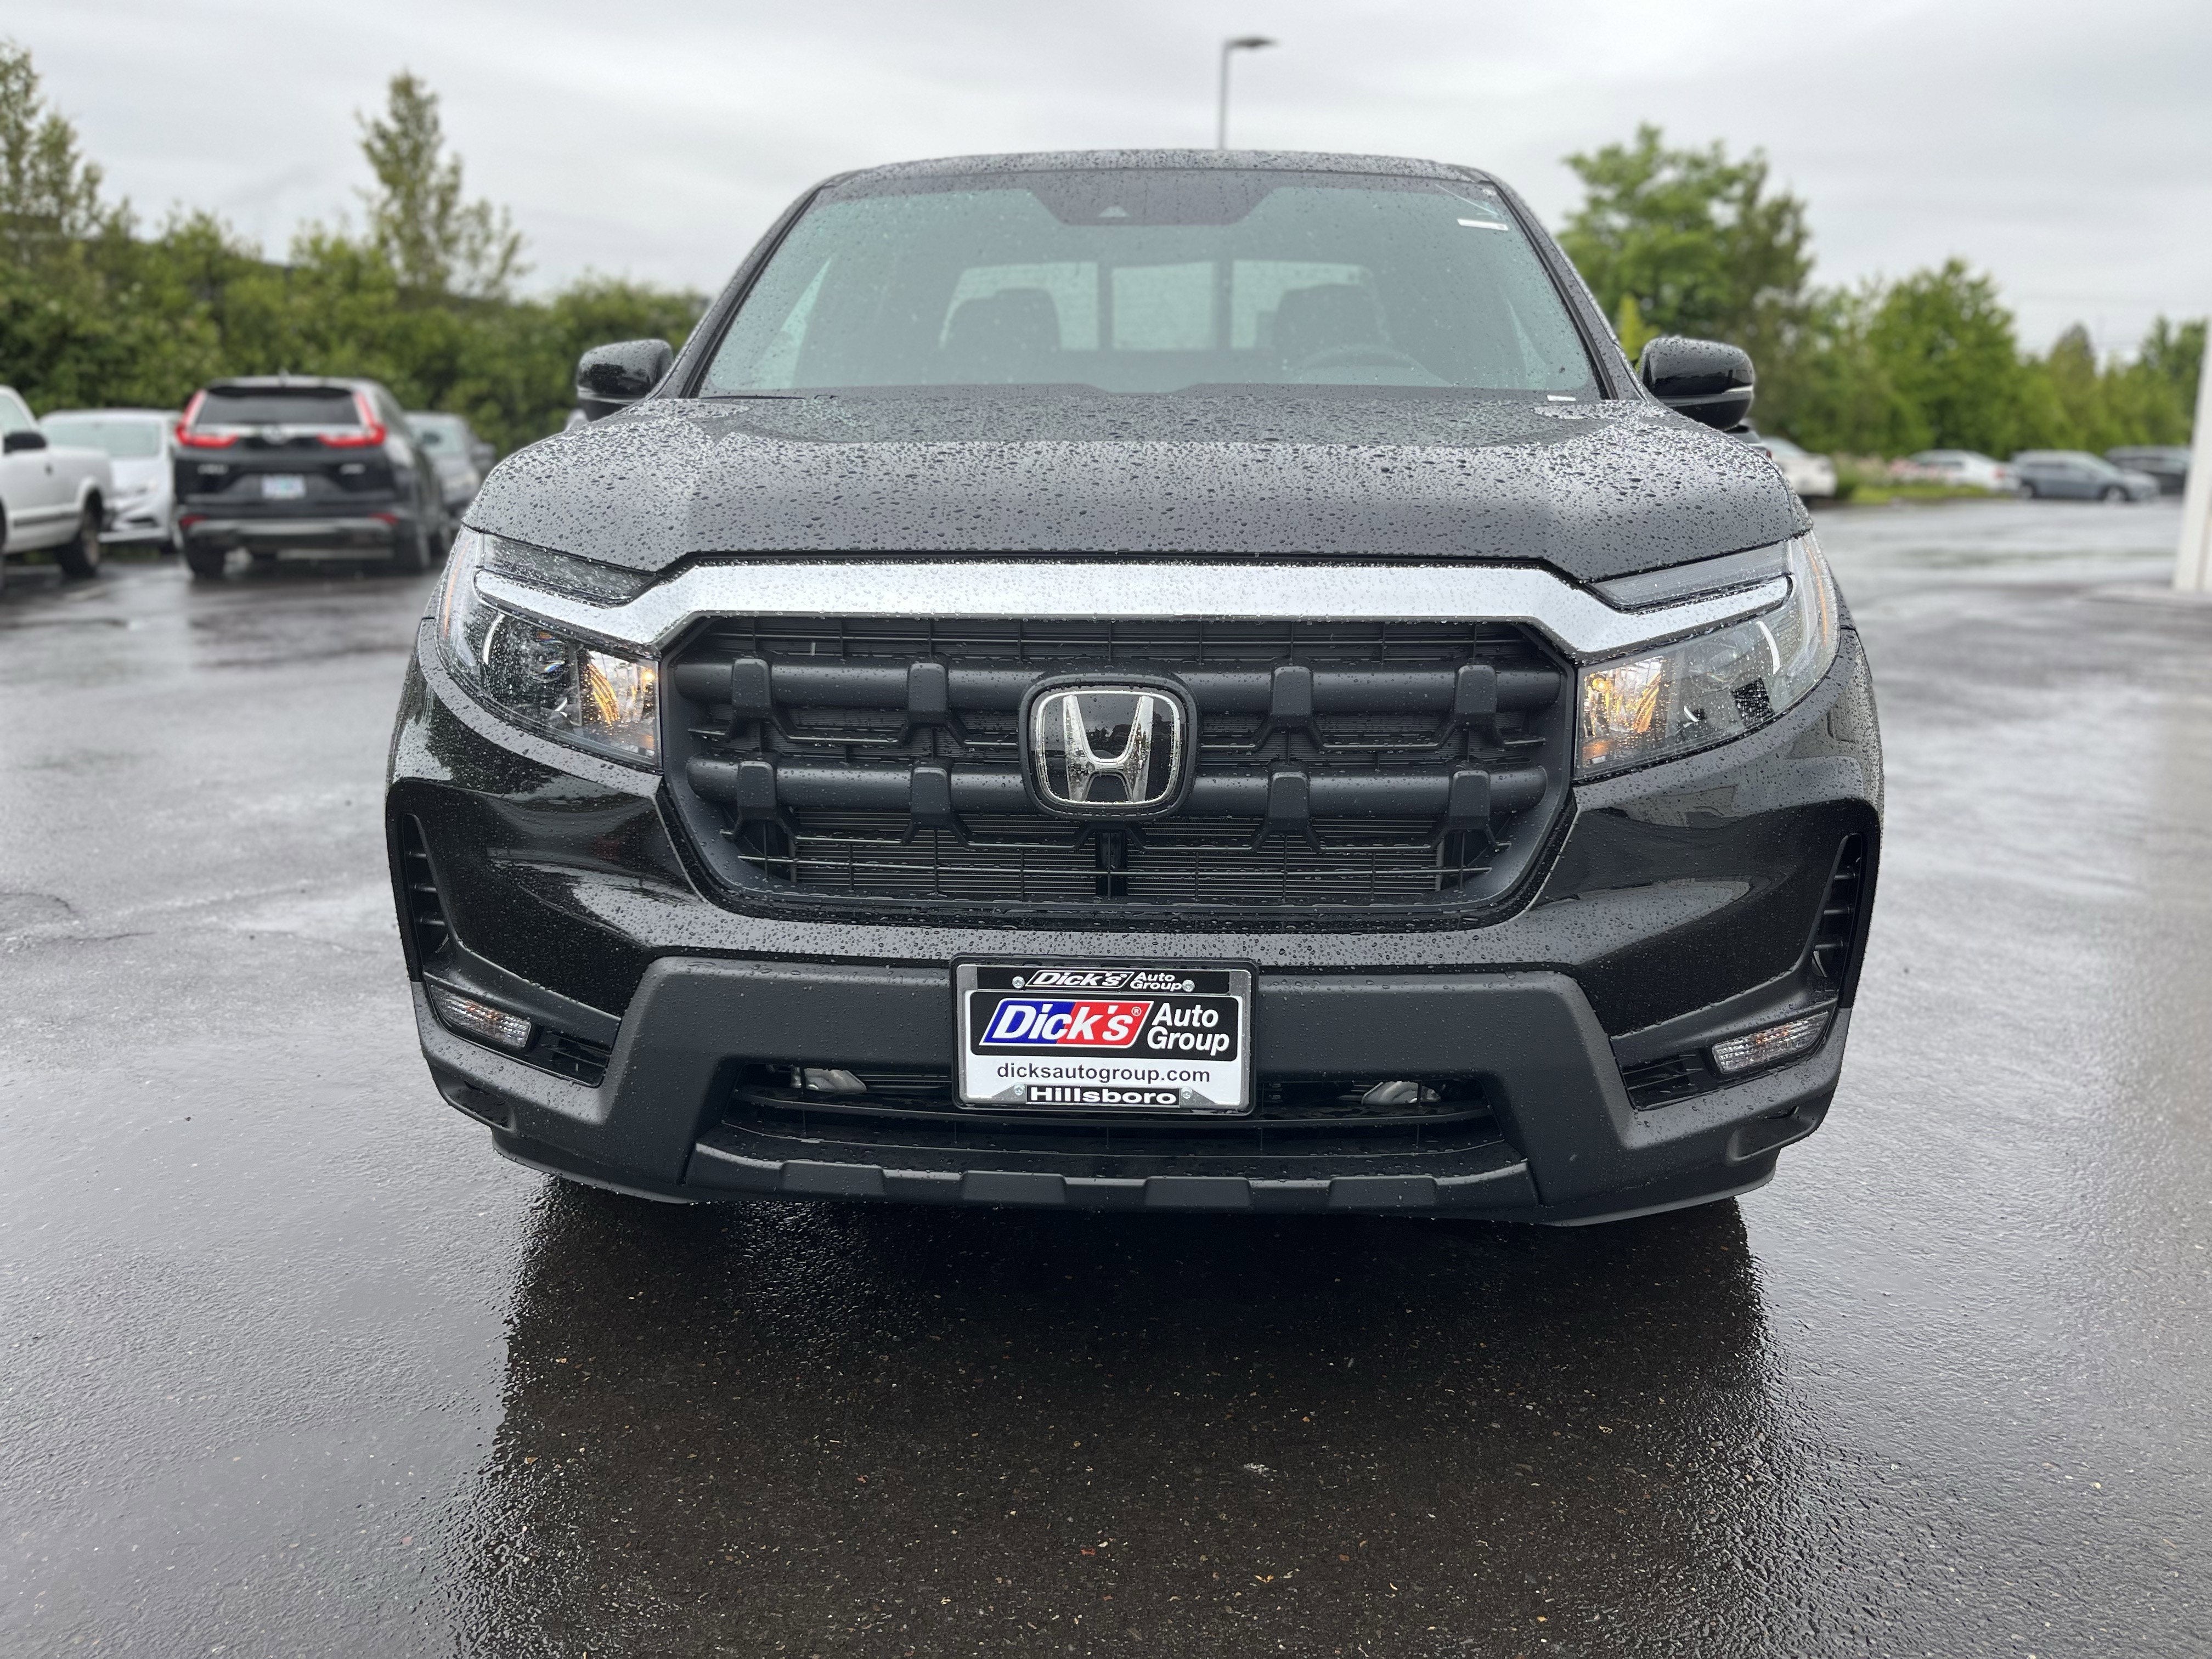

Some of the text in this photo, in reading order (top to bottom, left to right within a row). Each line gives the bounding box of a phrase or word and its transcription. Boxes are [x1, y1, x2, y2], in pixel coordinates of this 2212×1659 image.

[1130, 980, 1182, 991] Group
[1133, 972, 1175, 982] Auto
[1152, 1002, 1219, 1028] Auto
[1147, 1026, 1229, 1056] Group
[997, 1062, 1210, 1084] dicksautogroup.com
[1030, 1086, 1177, 1104] Hillsboro
